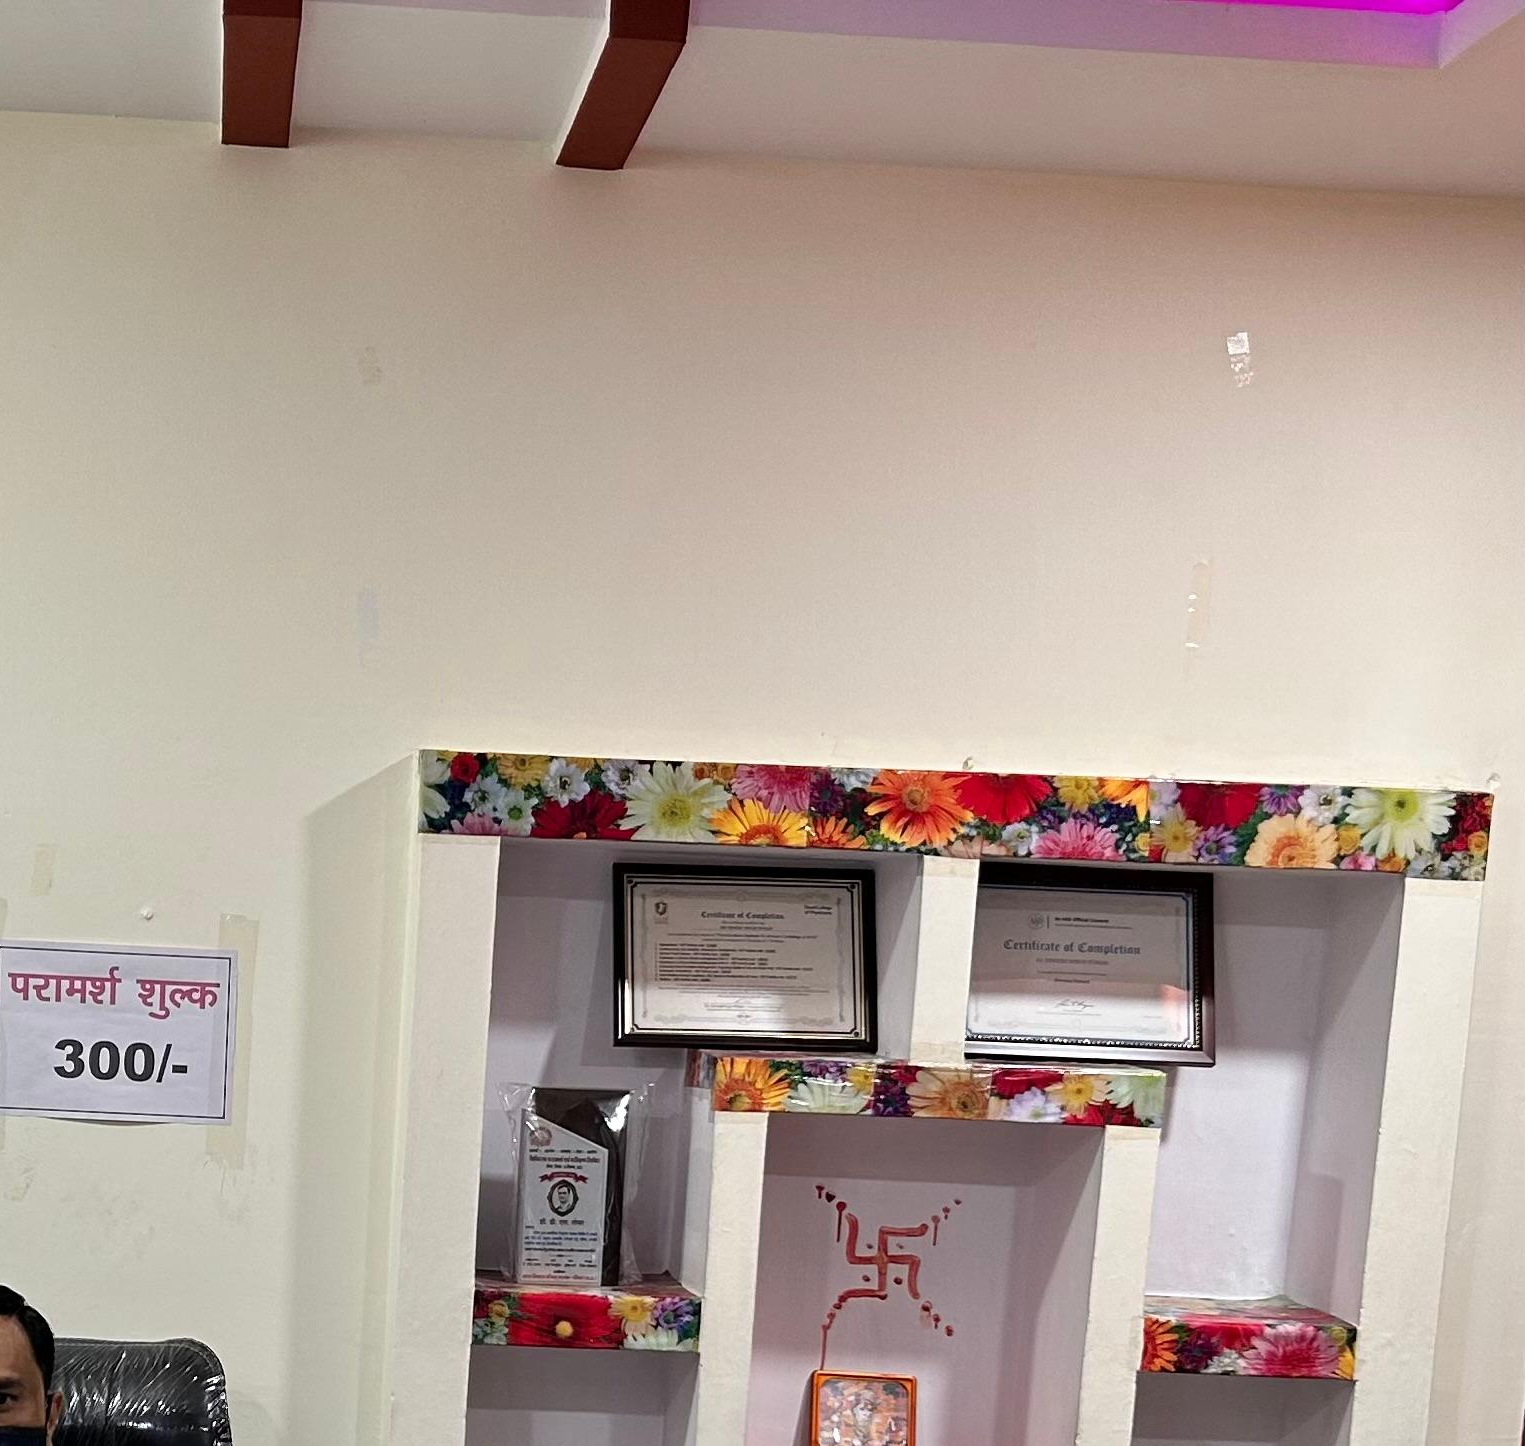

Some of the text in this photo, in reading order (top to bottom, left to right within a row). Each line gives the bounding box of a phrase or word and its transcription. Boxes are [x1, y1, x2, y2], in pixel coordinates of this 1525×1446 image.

[1003, 939, 1141, 955] Certificate of Completion
[8, 966, 221, 1020] परामर्श शुल्क
[53, 1038, 188, 1084] 300/-
